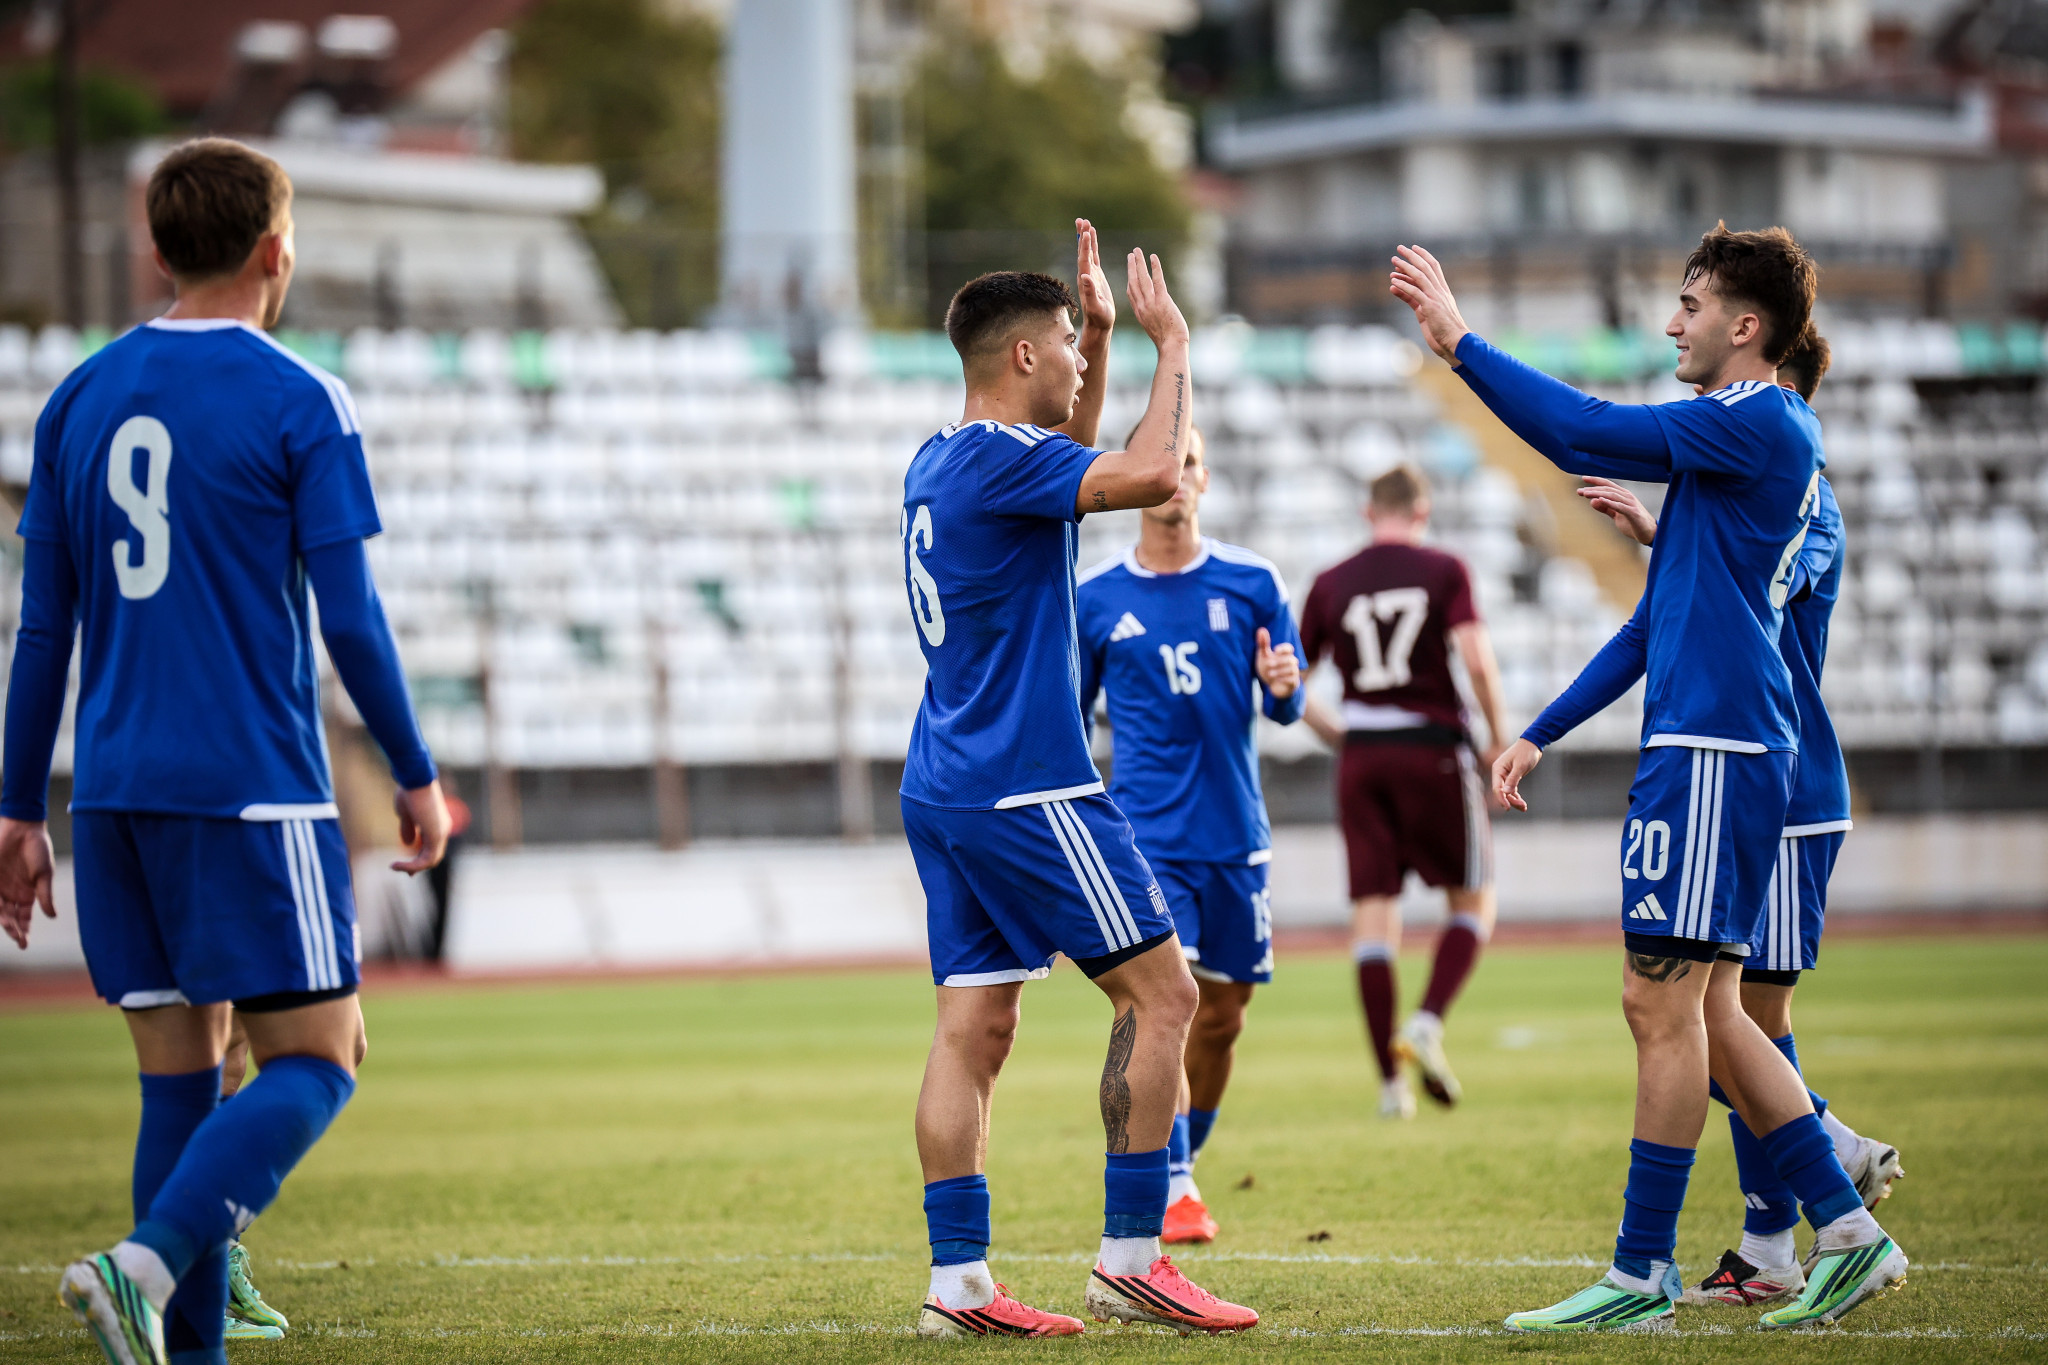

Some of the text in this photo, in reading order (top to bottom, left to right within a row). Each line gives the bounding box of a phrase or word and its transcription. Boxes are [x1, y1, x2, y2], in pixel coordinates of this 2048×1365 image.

[1164, 441, 1177, 457] You
[107, 415, 173, 600] 9
[1769, 469, 1821, 610] 2
[901, 504, 946, 648] 6
[1158, 641, 1202, 696] 15
[1341, 586, 1429, 692] 17
[1622, 818, 1671, 881] 20
